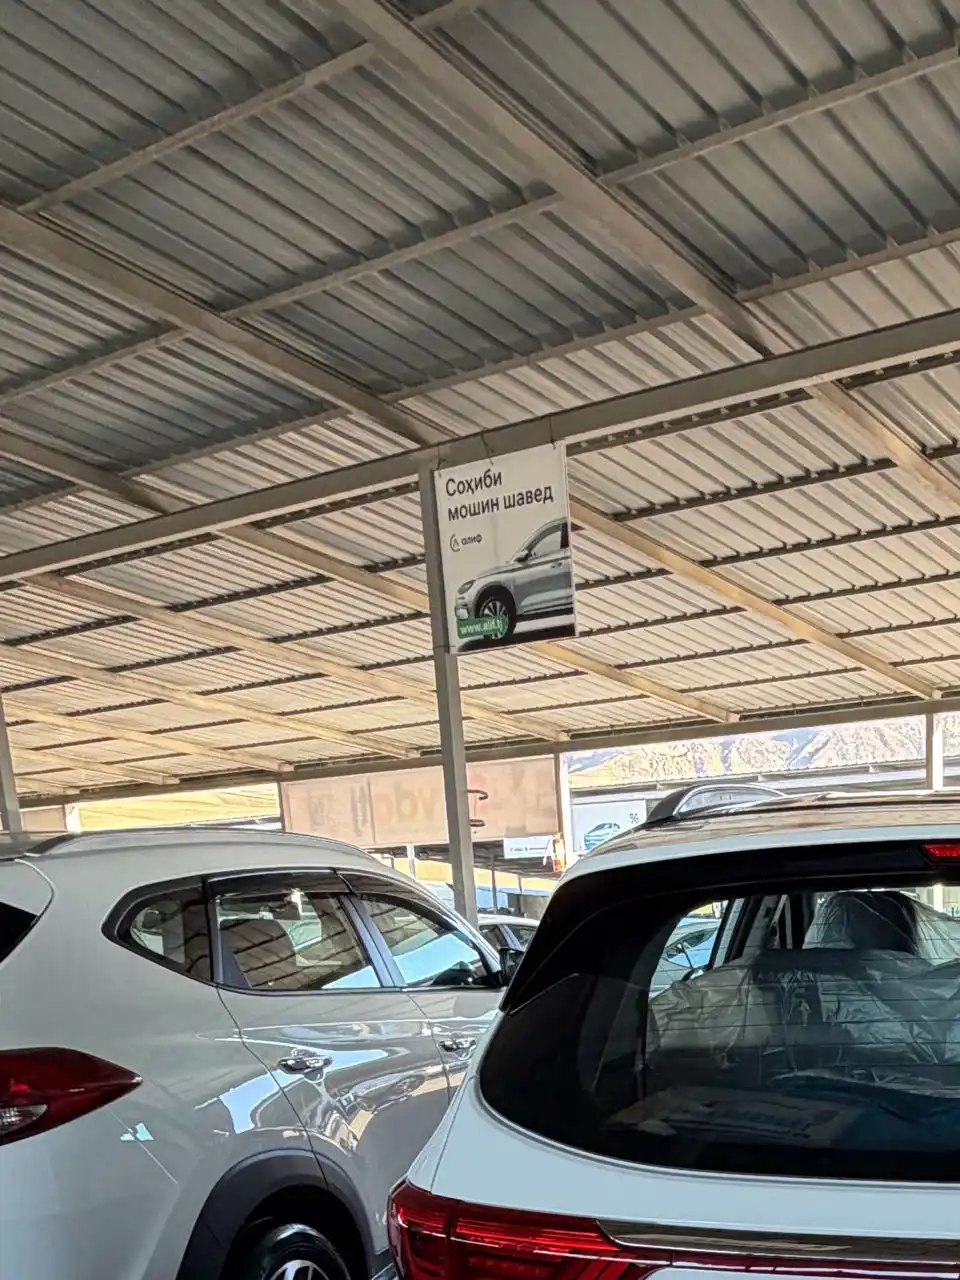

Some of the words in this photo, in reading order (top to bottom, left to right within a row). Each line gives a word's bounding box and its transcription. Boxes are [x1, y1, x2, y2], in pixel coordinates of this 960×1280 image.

[446, 468, 502, 496] Соҳиби
[448, 497, 499, 521] мошин
[503, 485, 554, 510] шавед
